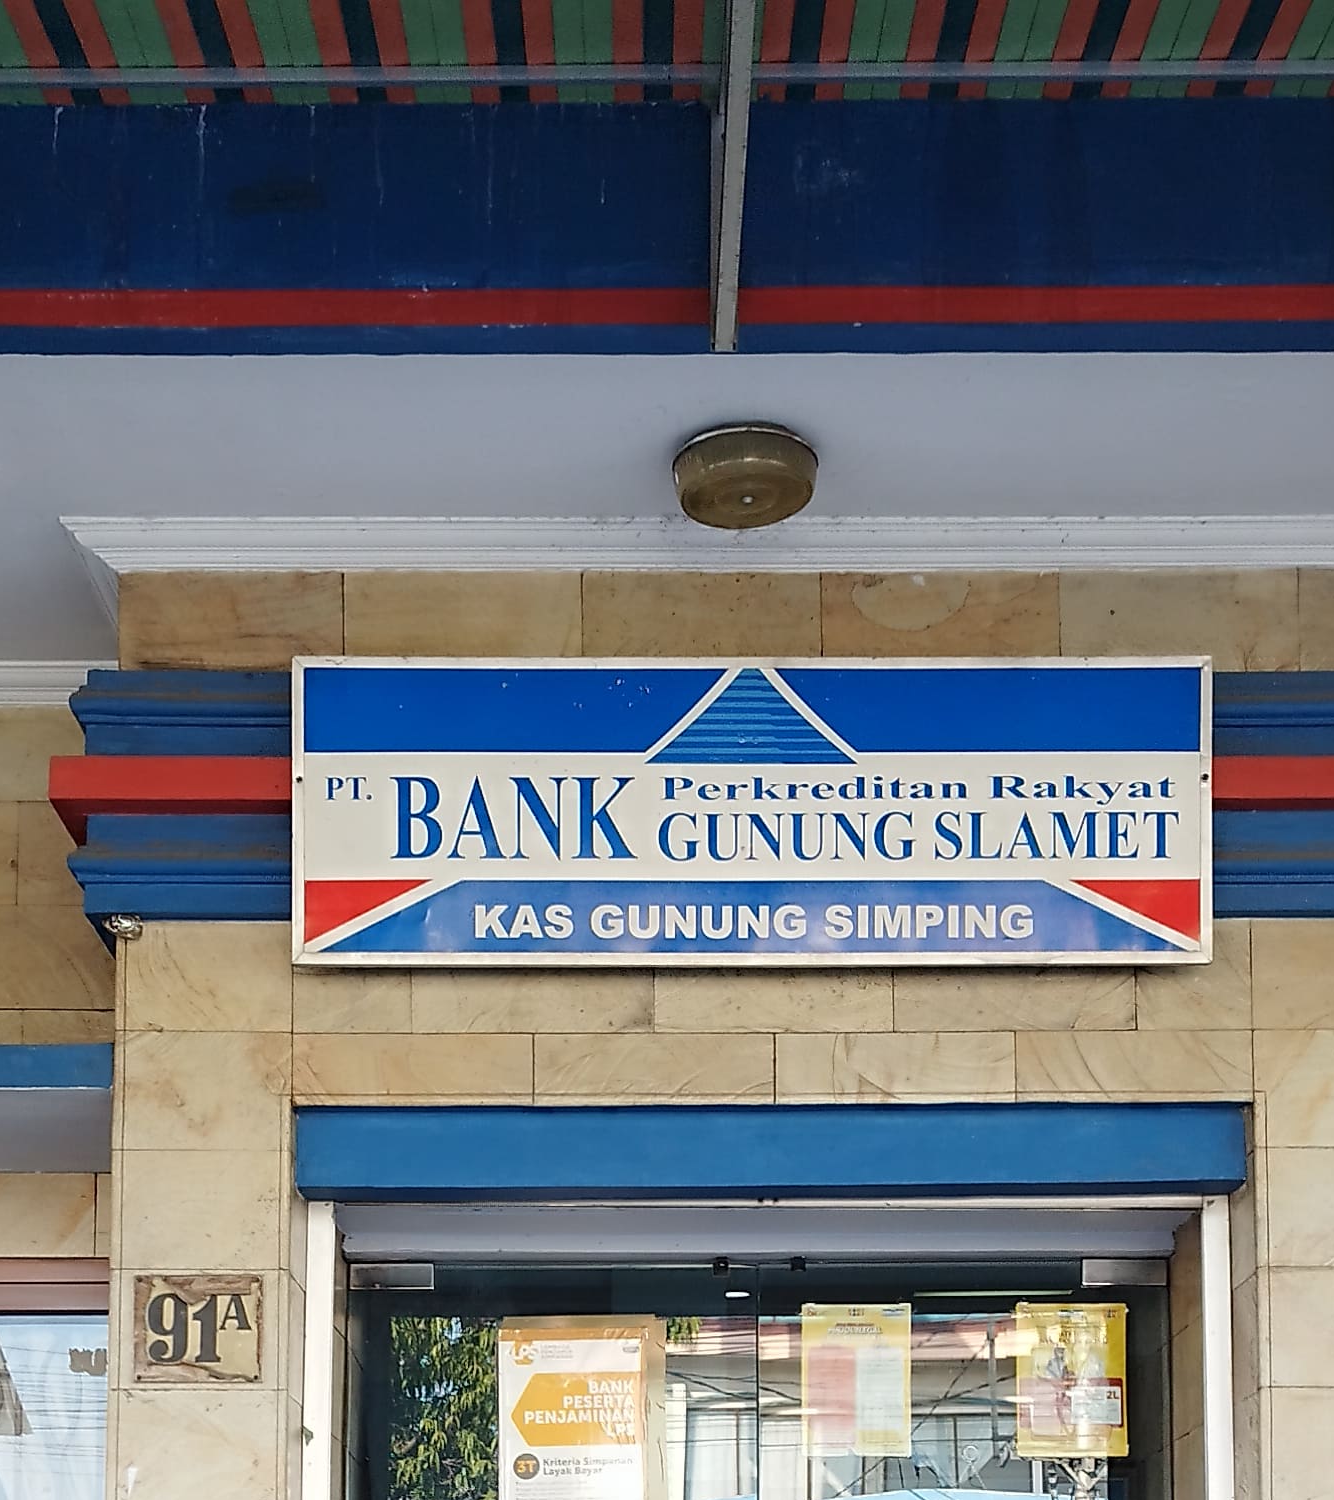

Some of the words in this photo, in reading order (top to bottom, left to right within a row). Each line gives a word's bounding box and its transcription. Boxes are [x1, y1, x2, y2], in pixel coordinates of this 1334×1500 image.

[325, 776, 373, 801] PT.
[389, 775, 639, 861] BANK
[660, 776, 967, 801] Perkreditan
[988, 775, 1176, 805] Rakyat
[657, 811, 917, 861] GUNUNG
[934, 810, 1180, 860] SLAMET
[473, 903, 574, 939] KAS
[590, 903, 807, 940] GUNUNG
[823, 903, 1034, 939] SIMPING
[588, 1379, 634, 1394] BANK
[563, 1395, 635, 1409] PESERTA
[524, 1410, 635, 1425] PENJAMINAN
[543, 1458, 581, 1467] Kriteria
[543, 1467, 572, 1477] Layak
